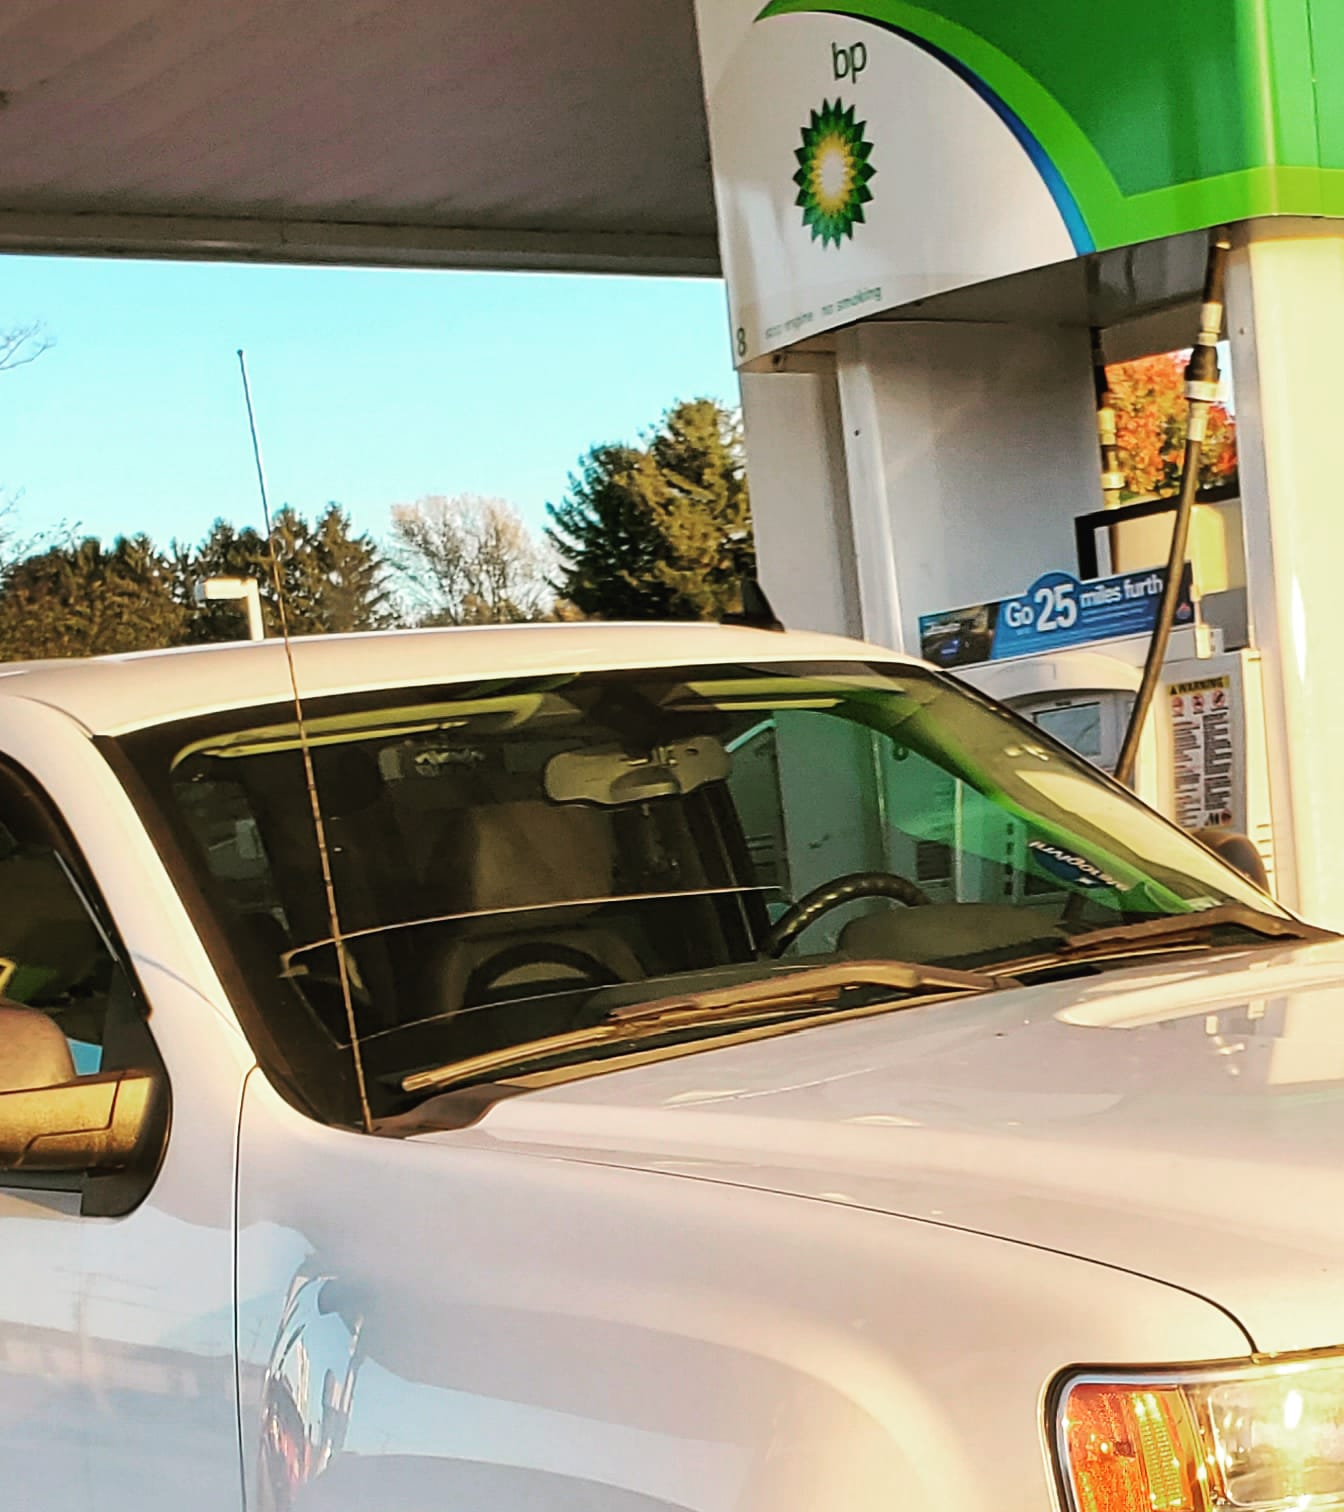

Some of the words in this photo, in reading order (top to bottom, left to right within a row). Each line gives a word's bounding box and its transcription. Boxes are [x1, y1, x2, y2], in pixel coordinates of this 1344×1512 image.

[831, 41, 867, 84] bp
[736, 326, 746, 357] 8
[1005, 601, 1034, 629] Go
[1034, 583, 1077, 632] 25
[1079, 583, 1121, 609] miles
[1122, 573, 1163, 600] furth
